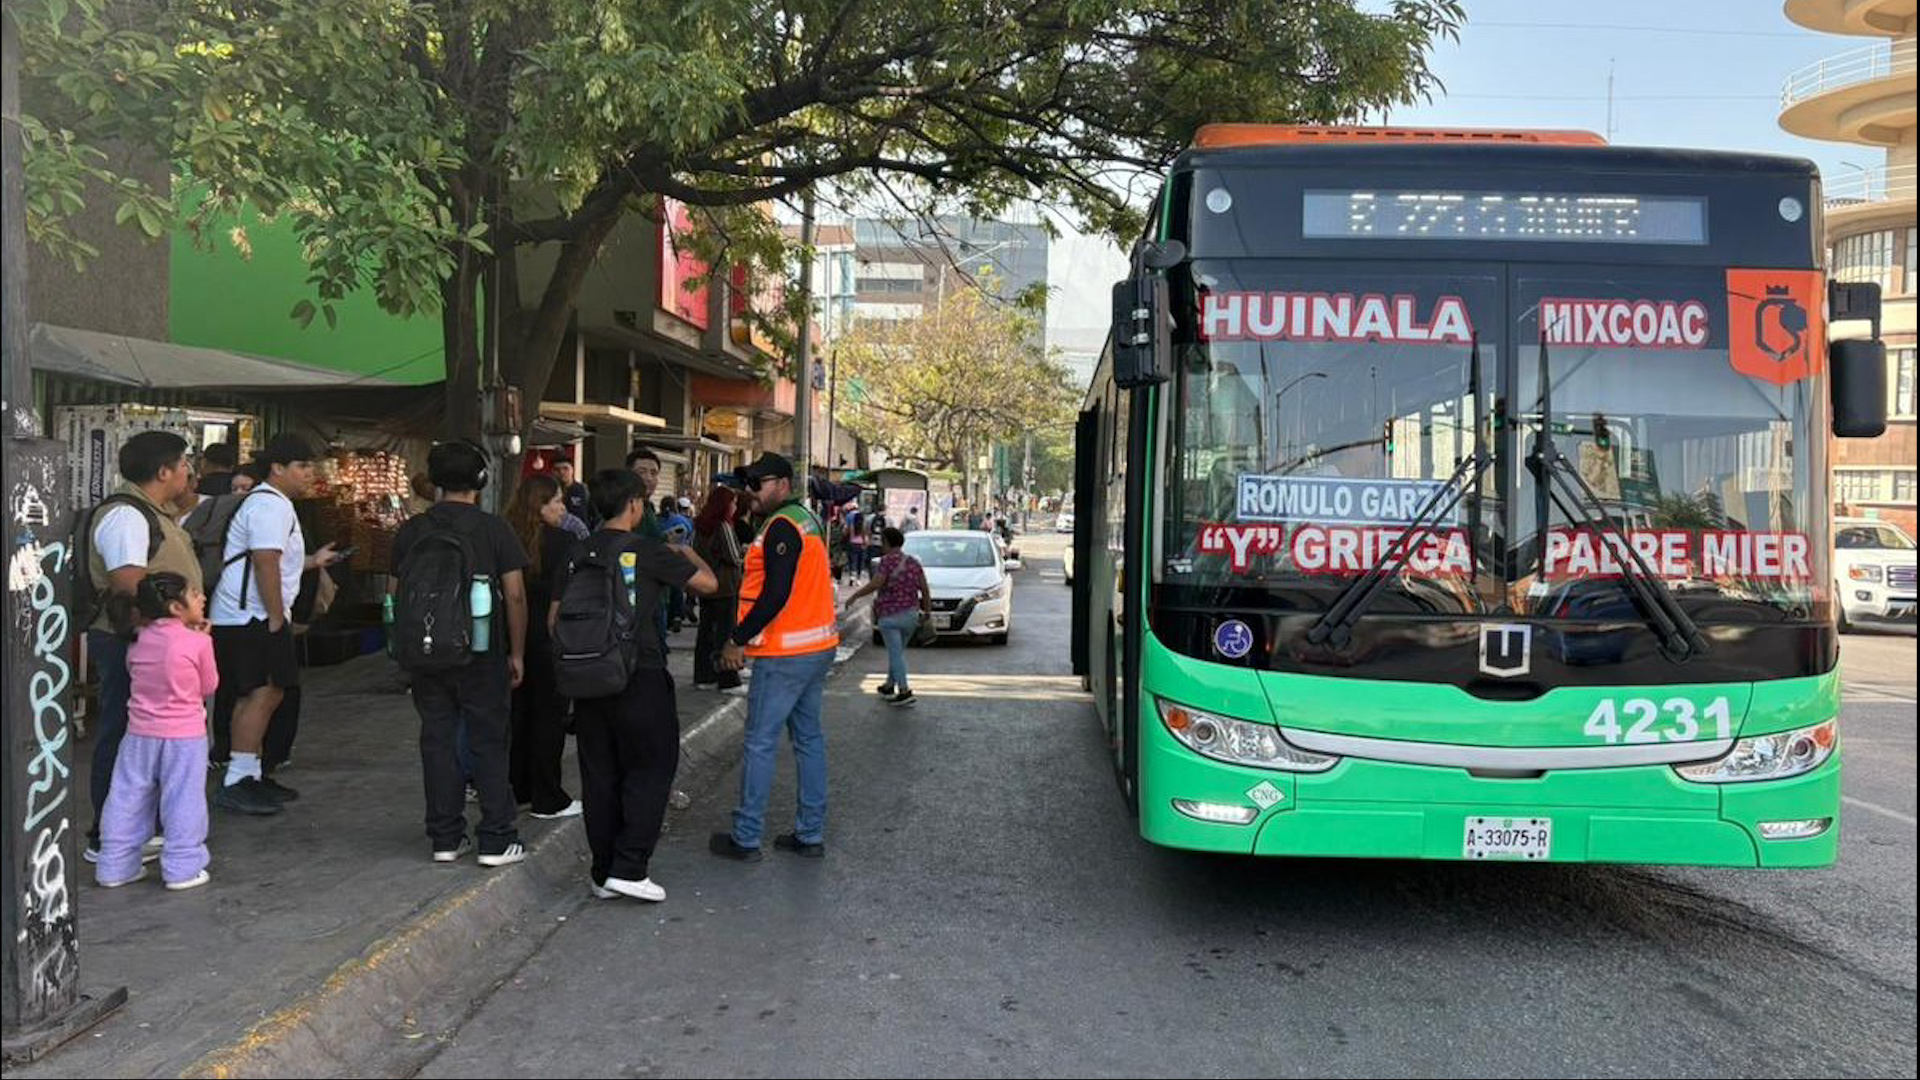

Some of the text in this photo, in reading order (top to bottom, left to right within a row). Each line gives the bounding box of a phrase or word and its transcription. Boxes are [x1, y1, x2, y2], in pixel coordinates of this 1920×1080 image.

[1202, 295, 1473, 341] HUINALA
[1542, 302, 1706, 345] MIXCOAC
[1293, 526, 1473, 573] GRIEGA
[1543, 531, 1810, 577] PADRE MIER
[1583, 695, 1731, 744] 4231
[1251, 787, 1280, 803] CNG
[1466, 828, 1548, 848] A-33075-R
